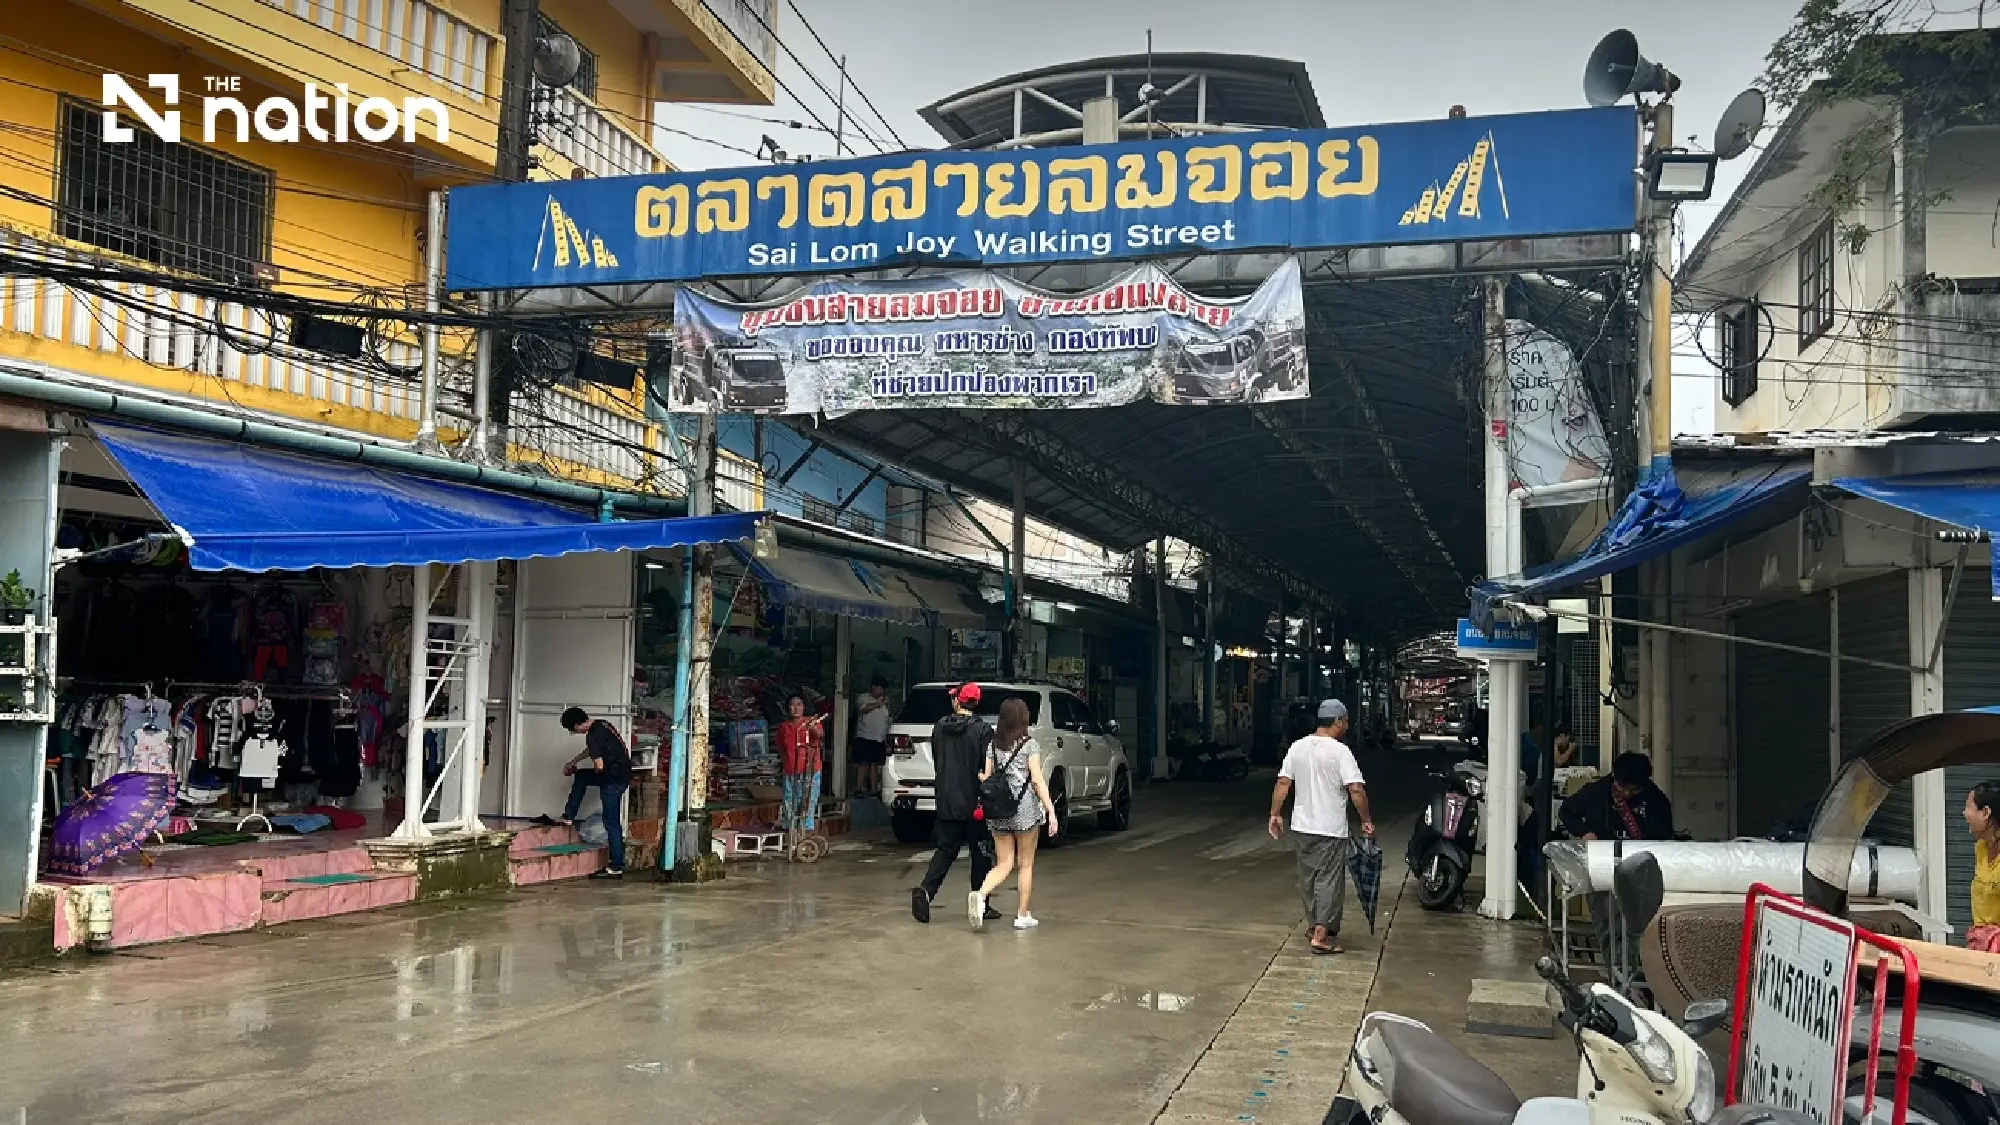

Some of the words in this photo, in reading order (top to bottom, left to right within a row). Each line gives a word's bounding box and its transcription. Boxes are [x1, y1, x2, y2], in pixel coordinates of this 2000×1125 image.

[634, 135, 1381, 238] ตลาดสายลมจอย
[748, 242, 797, 266] Sai
[810, 240, 878, 264] Lom
[896, 230, 957, 258] Joy
[973, 228, 1112, 257] Walking
[1127, 219, 1236, 248] Street
[805, 333, 924, 363] ขอขอบคุณ
